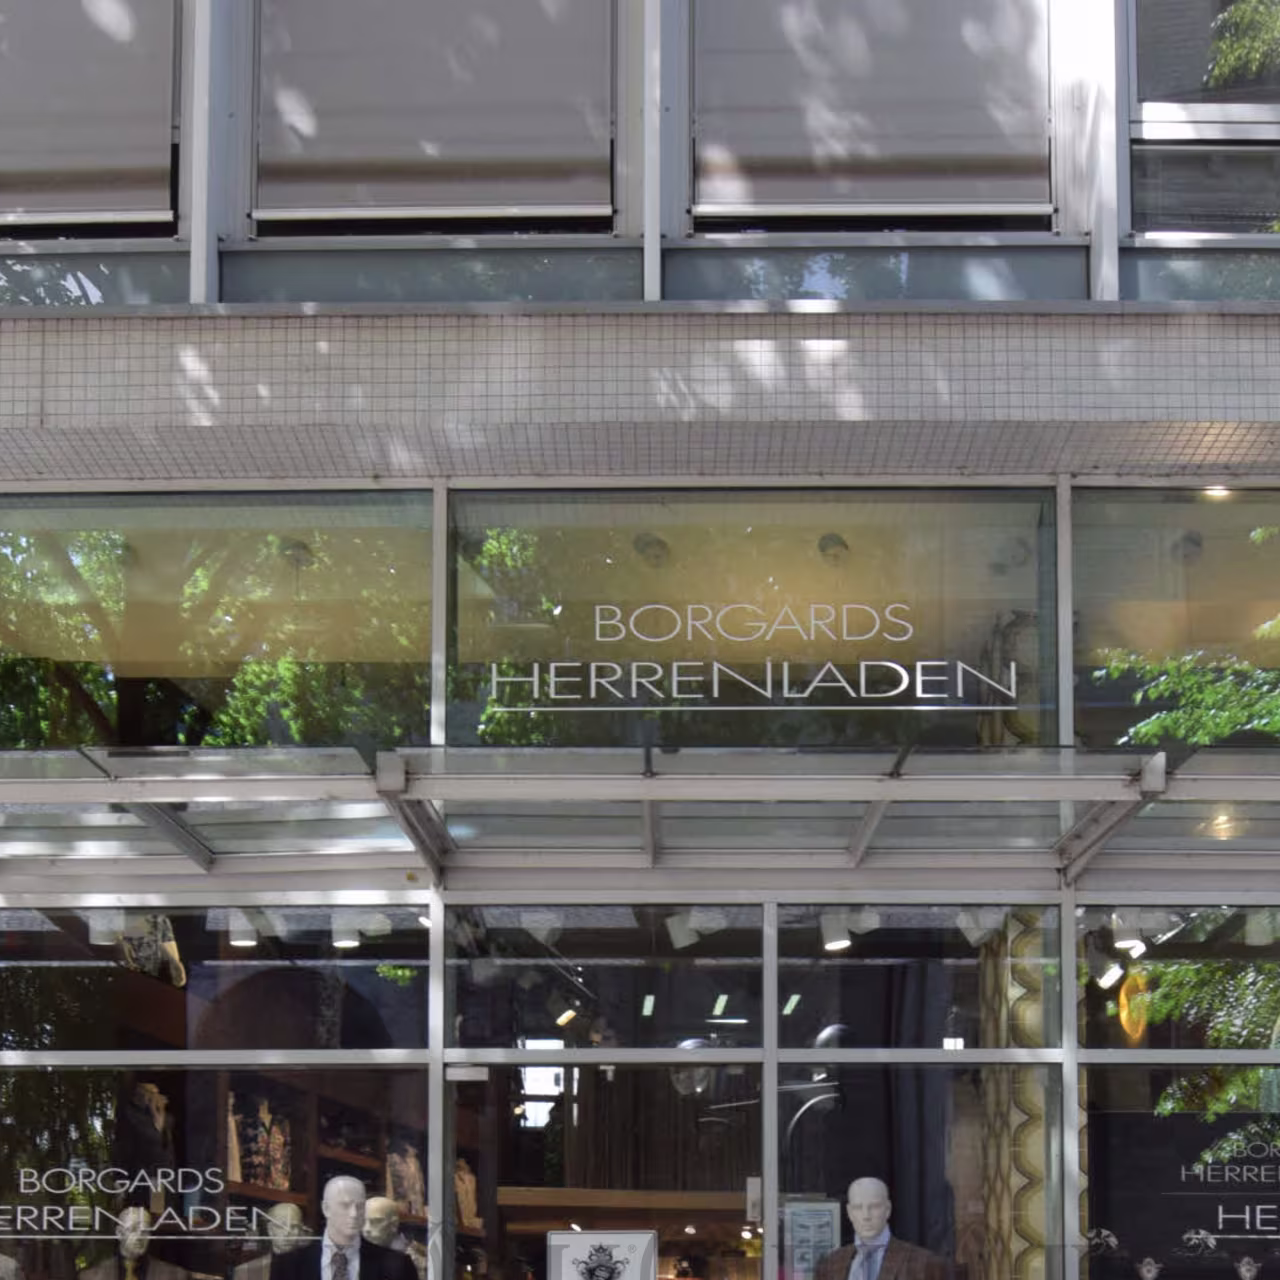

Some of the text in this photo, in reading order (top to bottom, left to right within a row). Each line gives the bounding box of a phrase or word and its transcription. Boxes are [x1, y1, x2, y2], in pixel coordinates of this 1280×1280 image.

[595, 603, 915, 642] BORGARDS
[491, 656, 1018, 699] HERRENLADEN
[20, 1168, 224, 1194] BORGARDS
